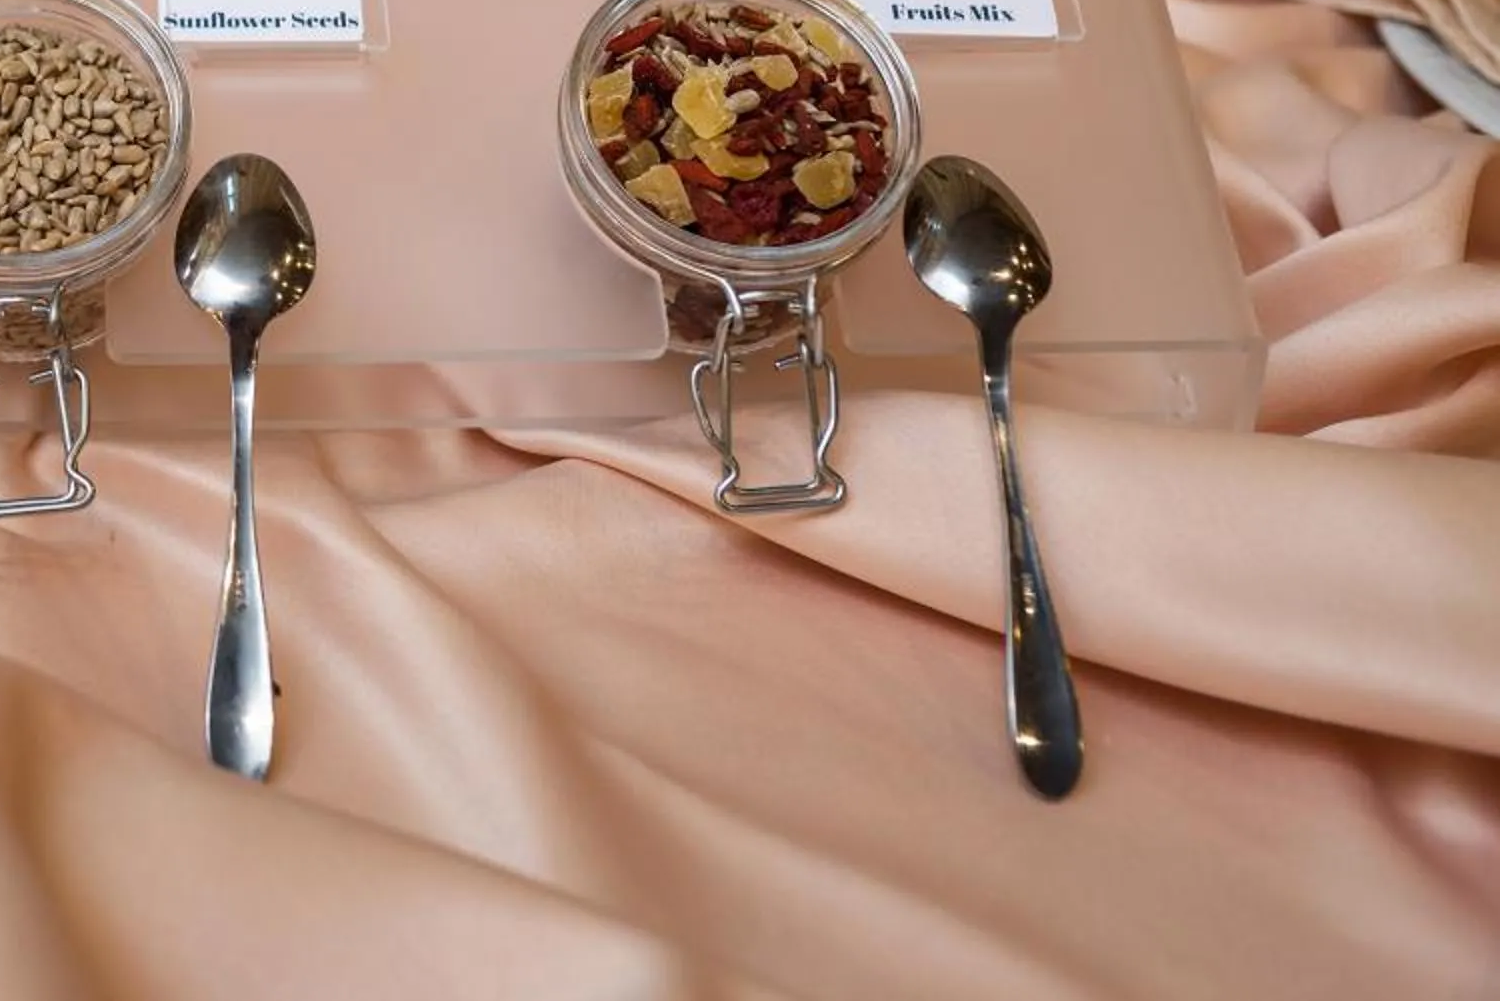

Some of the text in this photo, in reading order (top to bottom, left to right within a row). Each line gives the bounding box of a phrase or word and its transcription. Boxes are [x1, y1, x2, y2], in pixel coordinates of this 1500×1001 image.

[163, 11, 359, 29] Sunflower Seeds
[891, 3, 1016, 23] Fruits Mix
